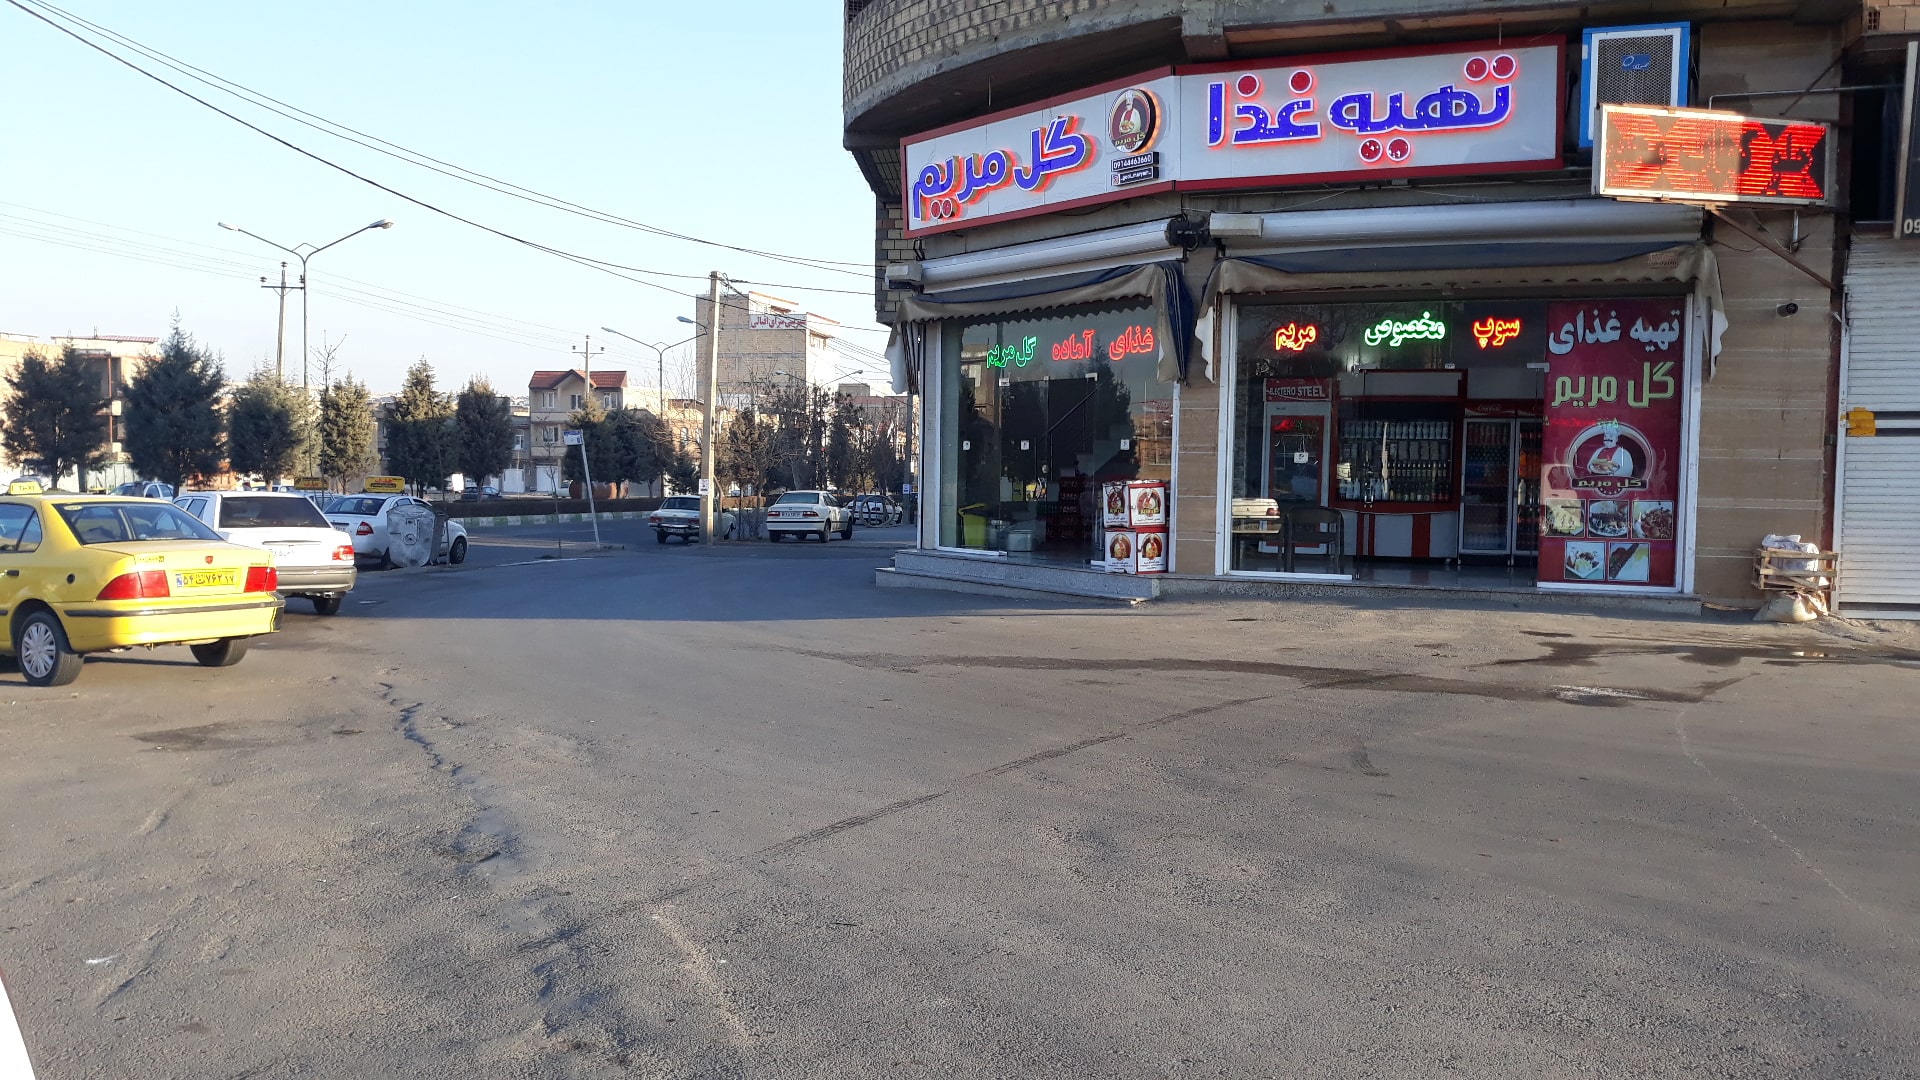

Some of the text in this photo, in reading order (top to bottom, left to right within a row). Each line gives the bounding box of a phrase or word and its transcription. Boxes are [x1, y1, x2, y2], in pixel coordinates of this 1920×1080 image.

[1207, 54, 1518, 162] تهیه غذا
[912, 115, 1089, 220] گل مریم
[986, 325, 1154, 369] غذای آماده گل مریم
[1275, 311, 1520, 351] سوپ مخصوص مریم
[1548, 309, 1681, 355] تهیه غذای
[1297, 385, 1326, 397] STEEL
[1551, 361, 1676, 408] گل مریم
[1578, 478, 1642, 488] گل مریم
